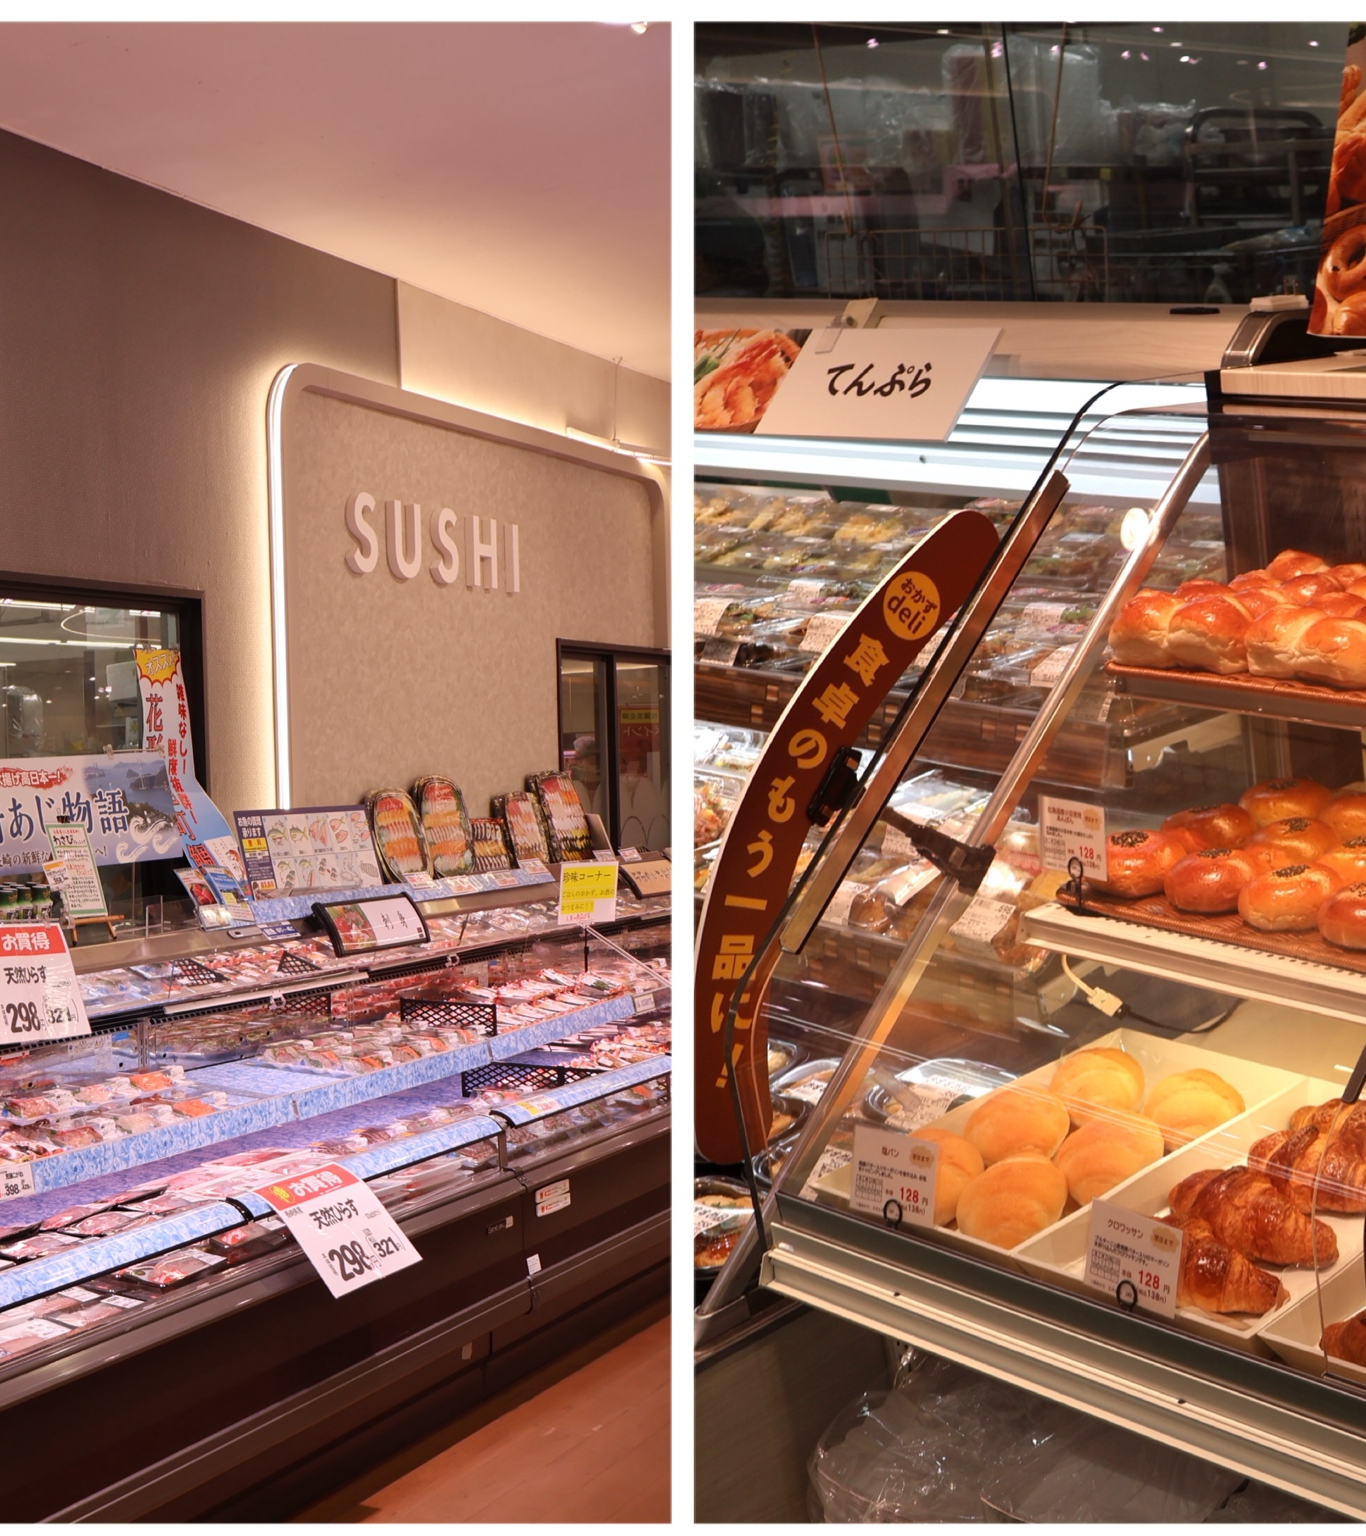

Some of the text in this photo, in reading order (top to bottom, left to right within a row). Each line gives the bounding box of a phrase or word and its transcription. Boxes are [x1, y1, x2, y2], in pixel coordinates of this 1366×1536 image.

[825, 361, 934, 399] てんぷら
[344, 490, 521, 594] SUSHI
[900, 577, 939, 614] おかず
[886, 594, 927, 636] deli
[562, 869, 613, 885] 珍味コーナー
[0, 931, 51, 952] お買得
[288, 1170, 344, 1197] お買得
[308, 1198, 360, 1230] 天然ひらす
[1107, 1218, 1144, 1240] クロワッサン
